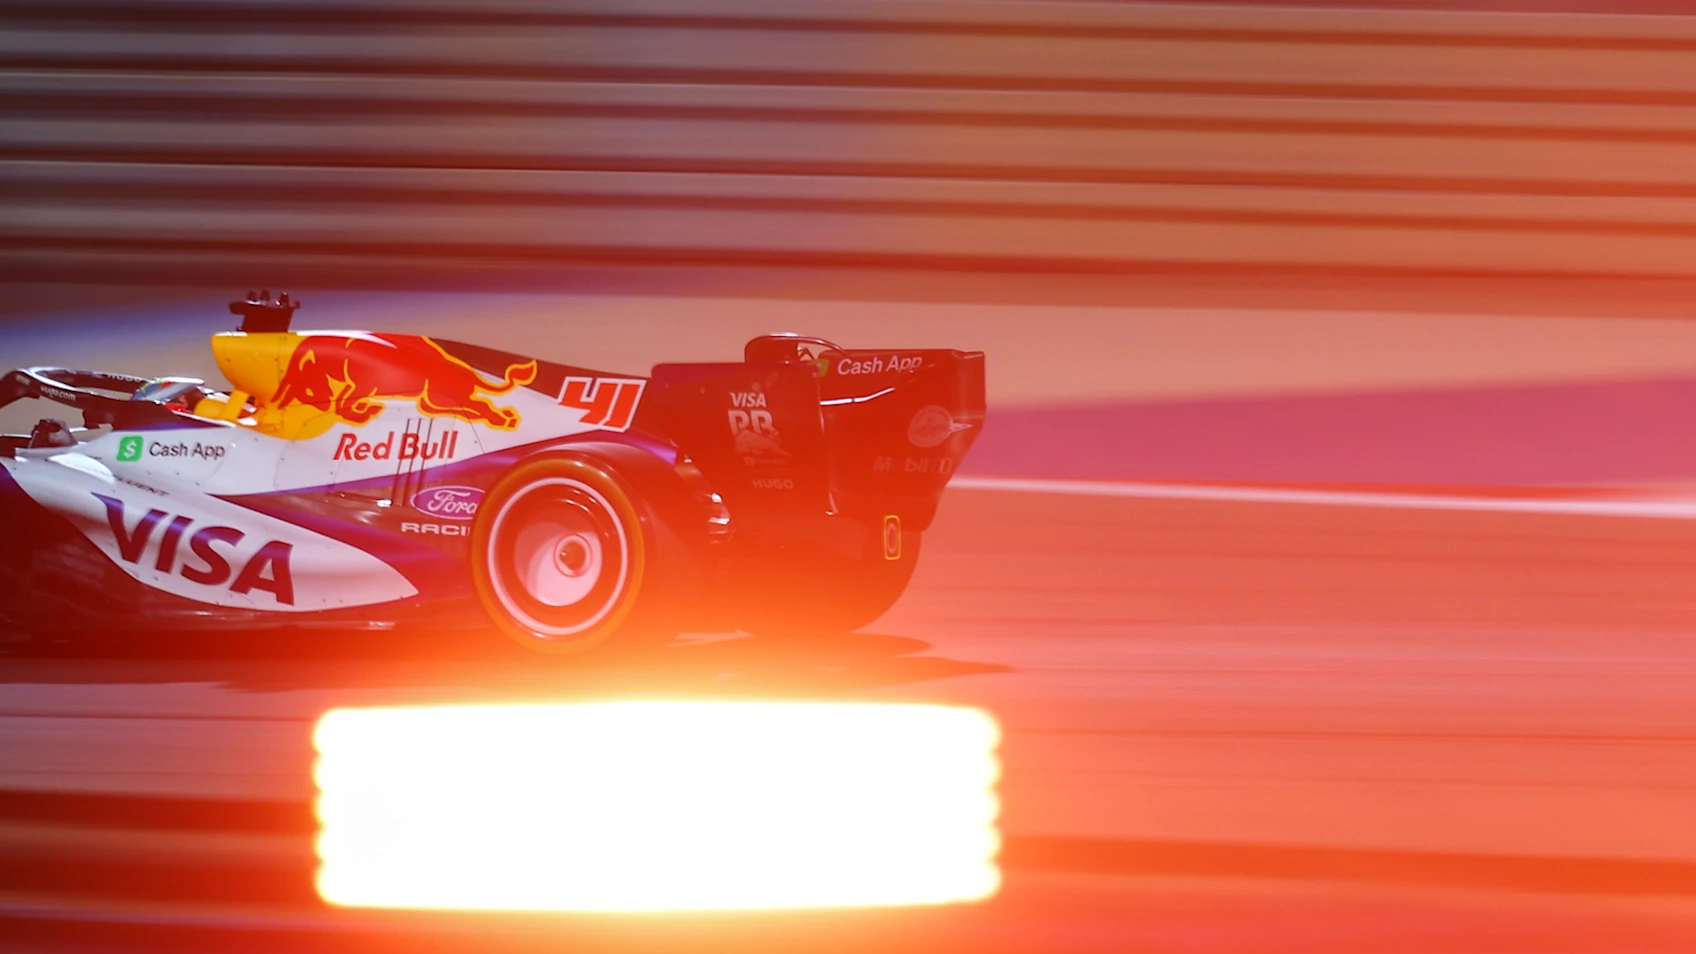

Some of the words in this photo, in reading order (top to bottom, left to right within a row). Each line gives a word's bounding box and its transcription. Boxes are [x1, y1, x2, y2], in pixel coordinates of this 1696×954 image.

[837, 357, 883, 376] Cash
[885, 354, 923, 374] App
[557, 376, 647, 433] 41
[729, 392, 767, 407] VISA
[149, 441, 188, 457] Cash
[192, 442, 225, 460] App
[333, 431, 395, 461] Red
[398, 430, 458, 460] Bull
[752, 479, 794, 489] HUGO
[401, 522, 471, 537] RACI
[91, 491, 295, 606] VISA
